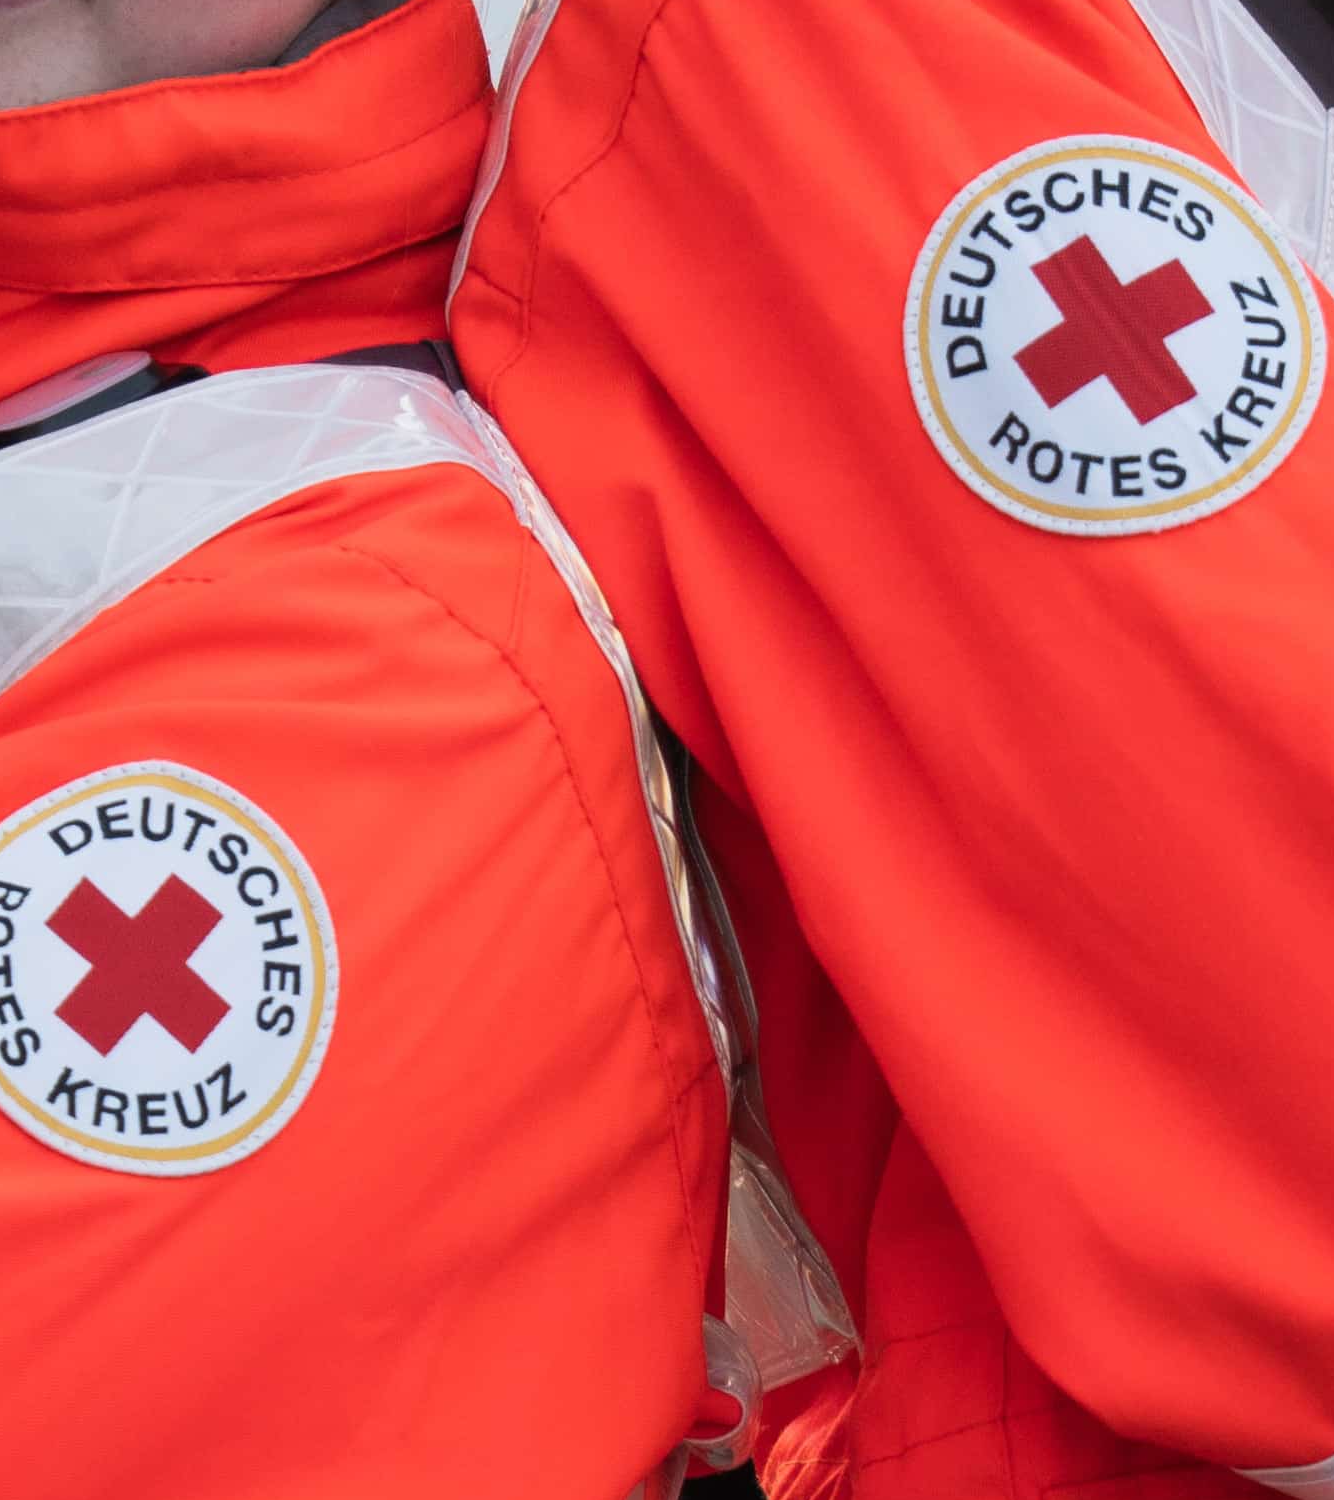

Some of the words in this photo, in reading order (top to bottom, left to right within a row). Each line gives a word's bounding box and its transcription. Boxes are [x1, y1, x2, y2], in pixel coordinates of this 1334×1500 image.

[941, 168, 1214, 379] DEUTSCHES
[989, 411, 1187, 497] ROTES
[1199, 276, 1287, 463] KREUZ
[48, 797, 302, 1037] DEUTSCHES
[45, 1061, 248, 1136] KREUZ
